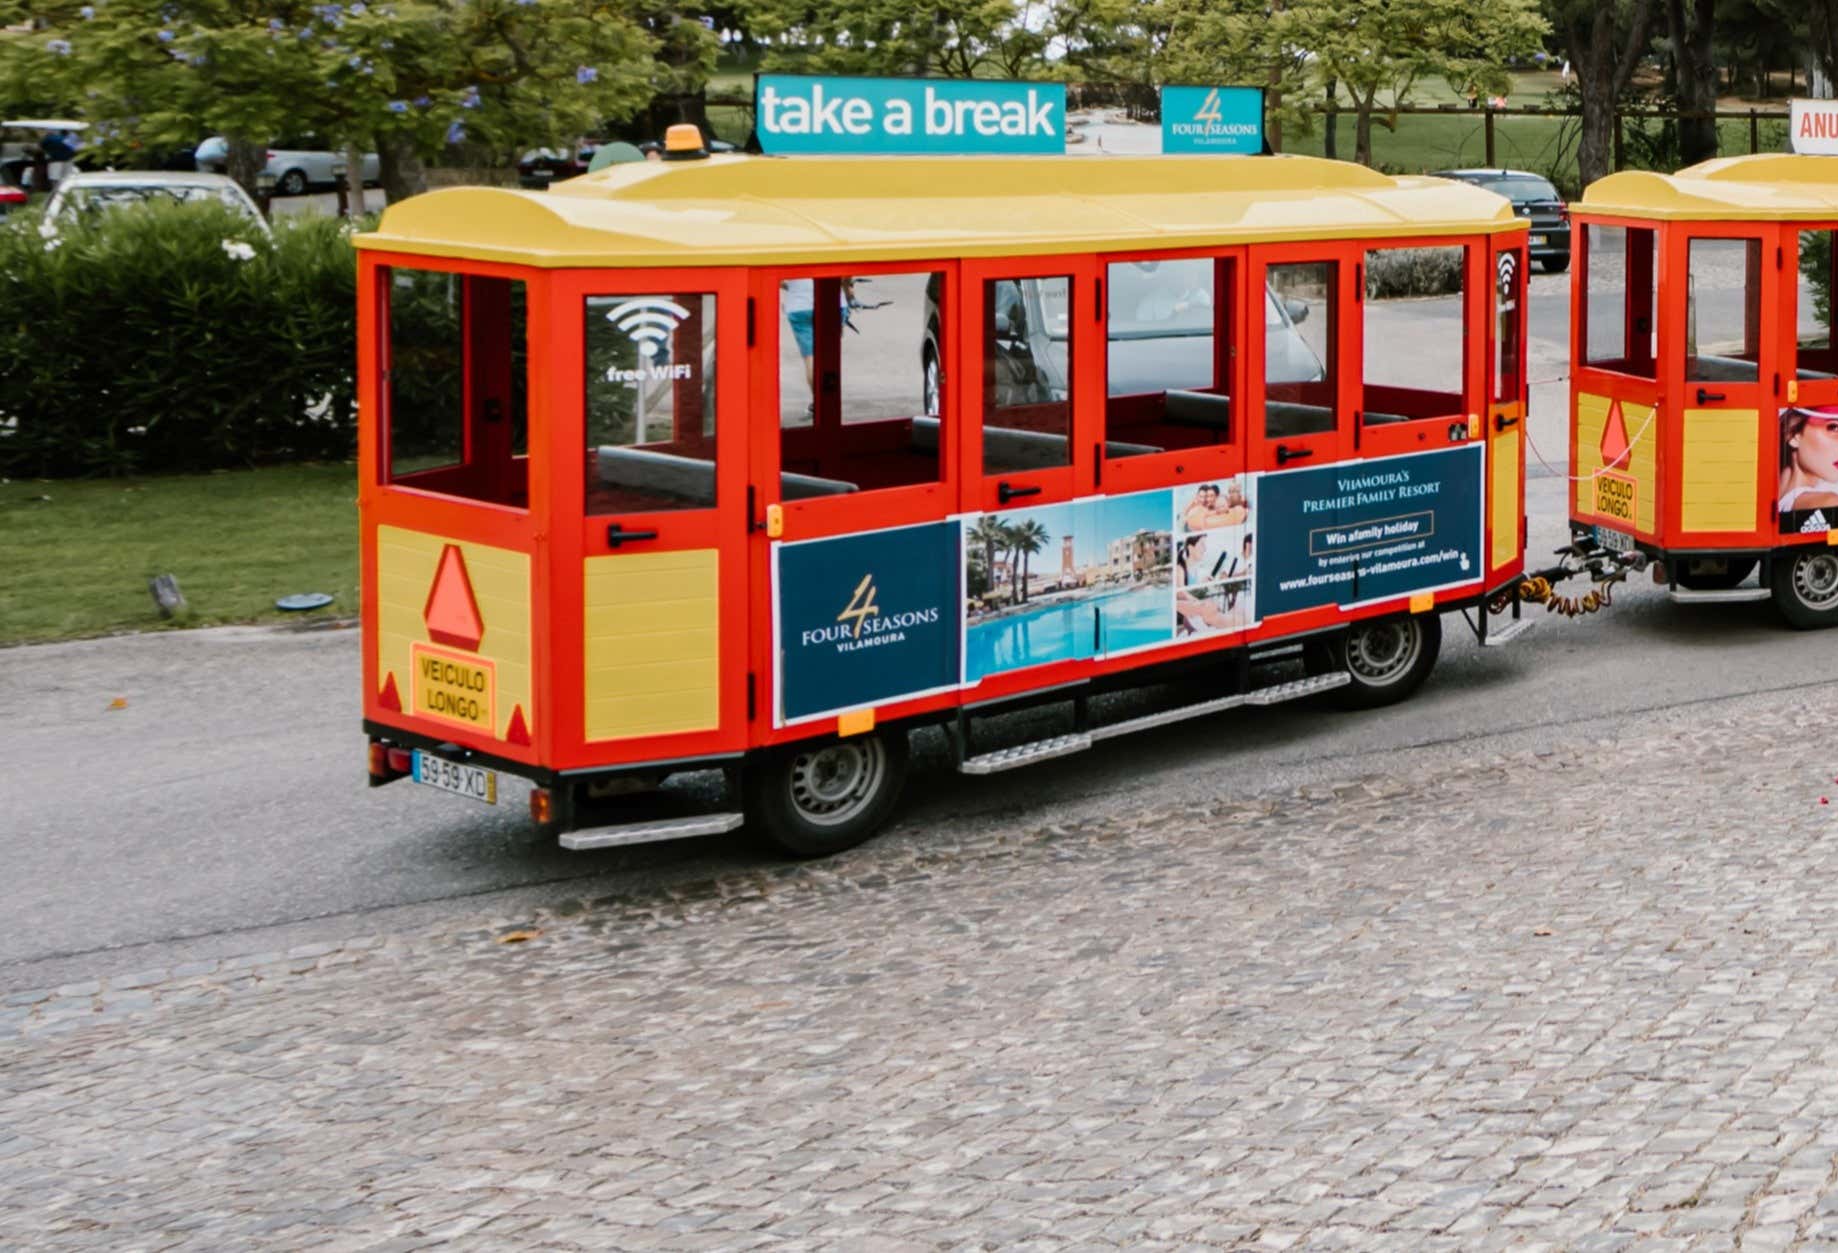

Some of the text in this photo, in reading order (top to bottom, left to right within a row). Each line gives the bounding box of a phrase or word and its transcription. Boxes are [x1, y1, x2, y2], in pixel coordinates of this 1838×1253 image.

[762, 84, 1056, 137] take a break
[1193, 87, 1222, 136] 4
[1172, 123, 1258, 136] FOUR SEASONS
[606, 363, 692, 382] free WiFi
[1302, 481, 1441, 513] PREMIER FAMILY RESORT
[1597, 476, 1633, 501] VEICULO
[1597, 495, 1629, 519] LONGO
[1326, 533, 1347, 545] Win
[1354, 526, 1383, 542] family
[1384, 520, 1419, 537] holiday
[1374, 542, 1414, 558] competition
[1279, 548, 1460, 592] www.fourseasns-vilamoura.com/win
[837, 574, 880, 639] 4
[802, 607, 939, 647] FOUR SEASONS
[836, 631, 906, 653] VILAMOURA
[421, 657, 485, 692] VEICULO
[428, 688, 479, 721] LONGO
[421, 755, 486, 797] 59-59-XD
